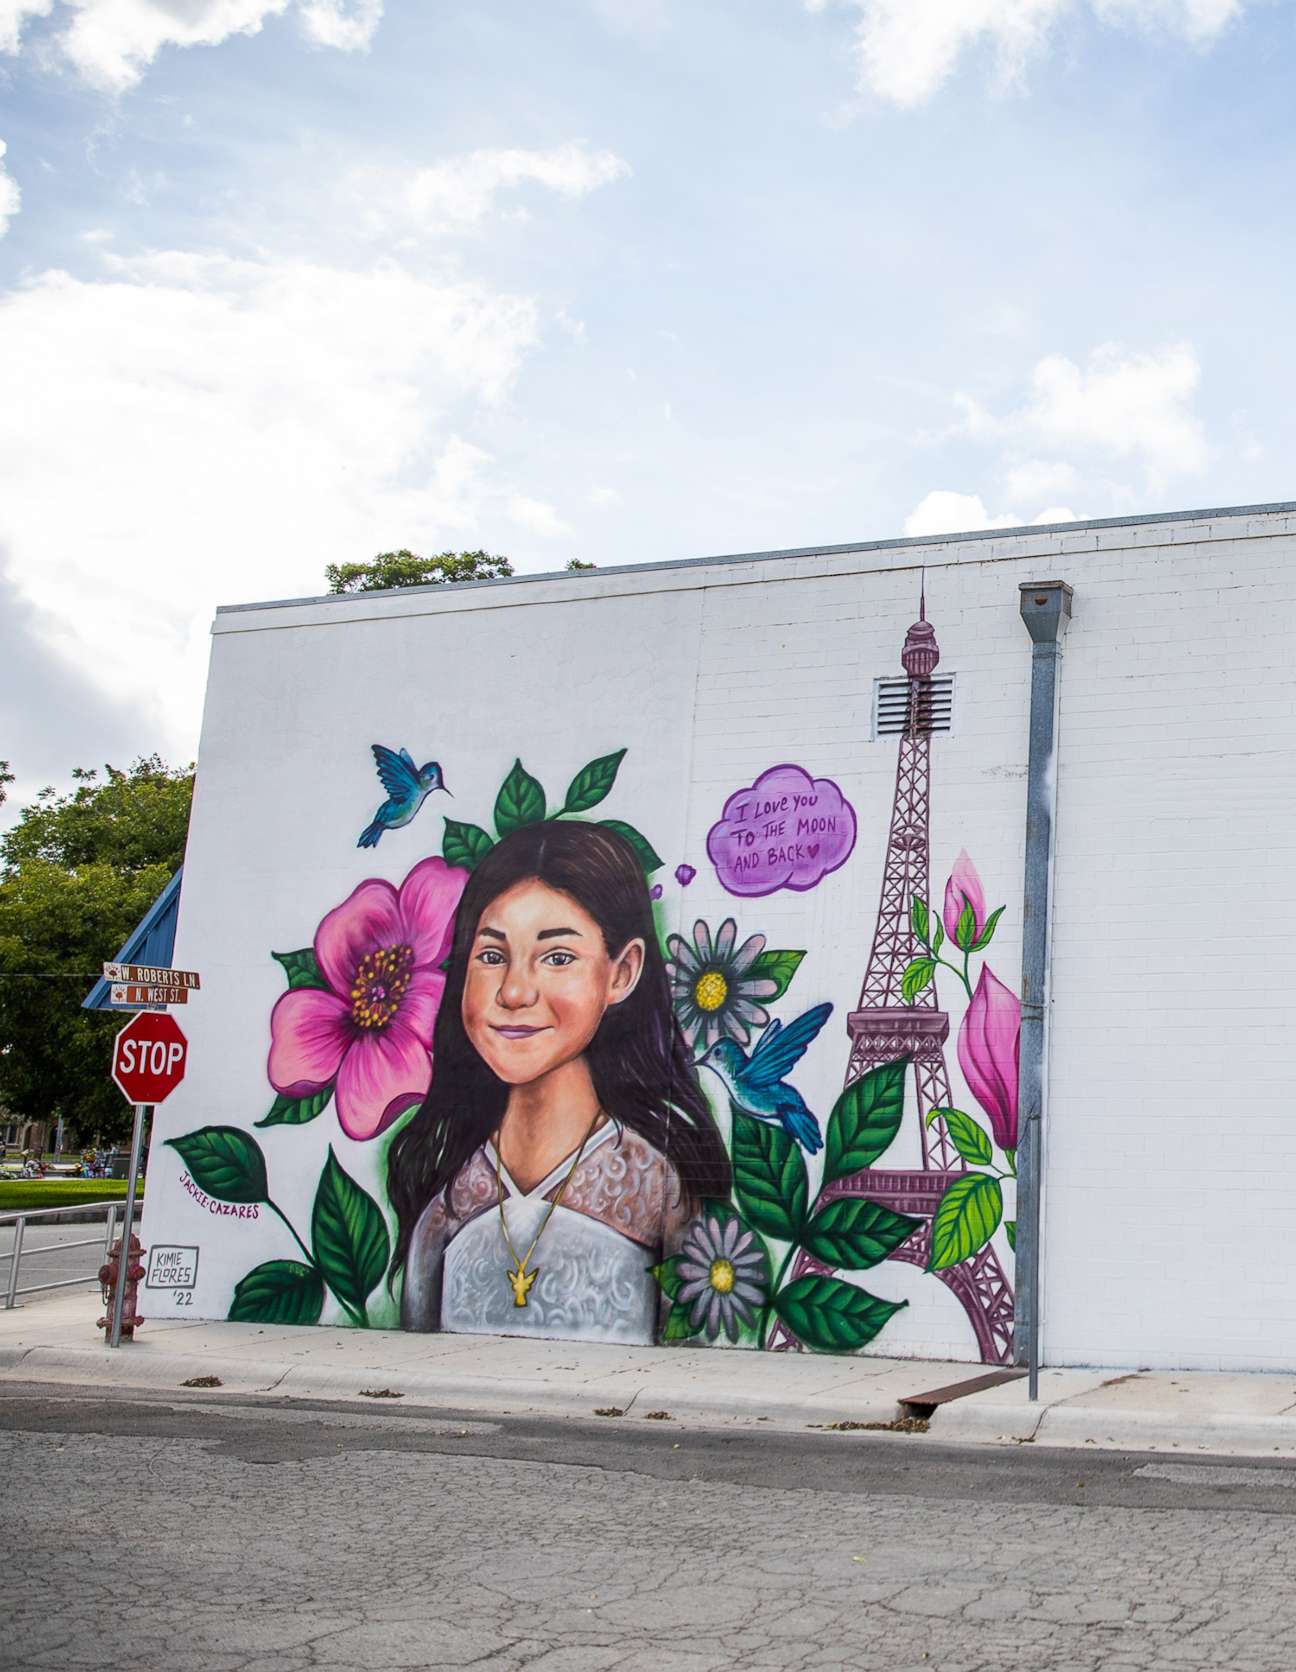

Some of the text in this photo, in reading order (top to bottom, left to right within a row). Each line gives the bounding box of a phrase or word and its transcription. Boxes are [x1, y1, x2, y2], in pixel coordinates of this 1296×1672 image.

[735, 802, 750, 824] I
[730, 816, 836, 846] TO THE MOON
[734, 844, 805, 872] AND BACK
[121, 965, 134, 981] W.
[137, 967, 180, 985] ROBERTS
[184, 973, 199, 988] LN.
[136, 988, 144, 1002] N.
[147, 988, 167, 1002] WEST
[170, 989, 181, 1002] ST.
[119, 1039, 183, 1075] STOP
[209, 1200, 259, 1219] CAZARES
[156, 1252, 183, 1266] KIMIE
[151, 1267, 191, 1283] FLORES
